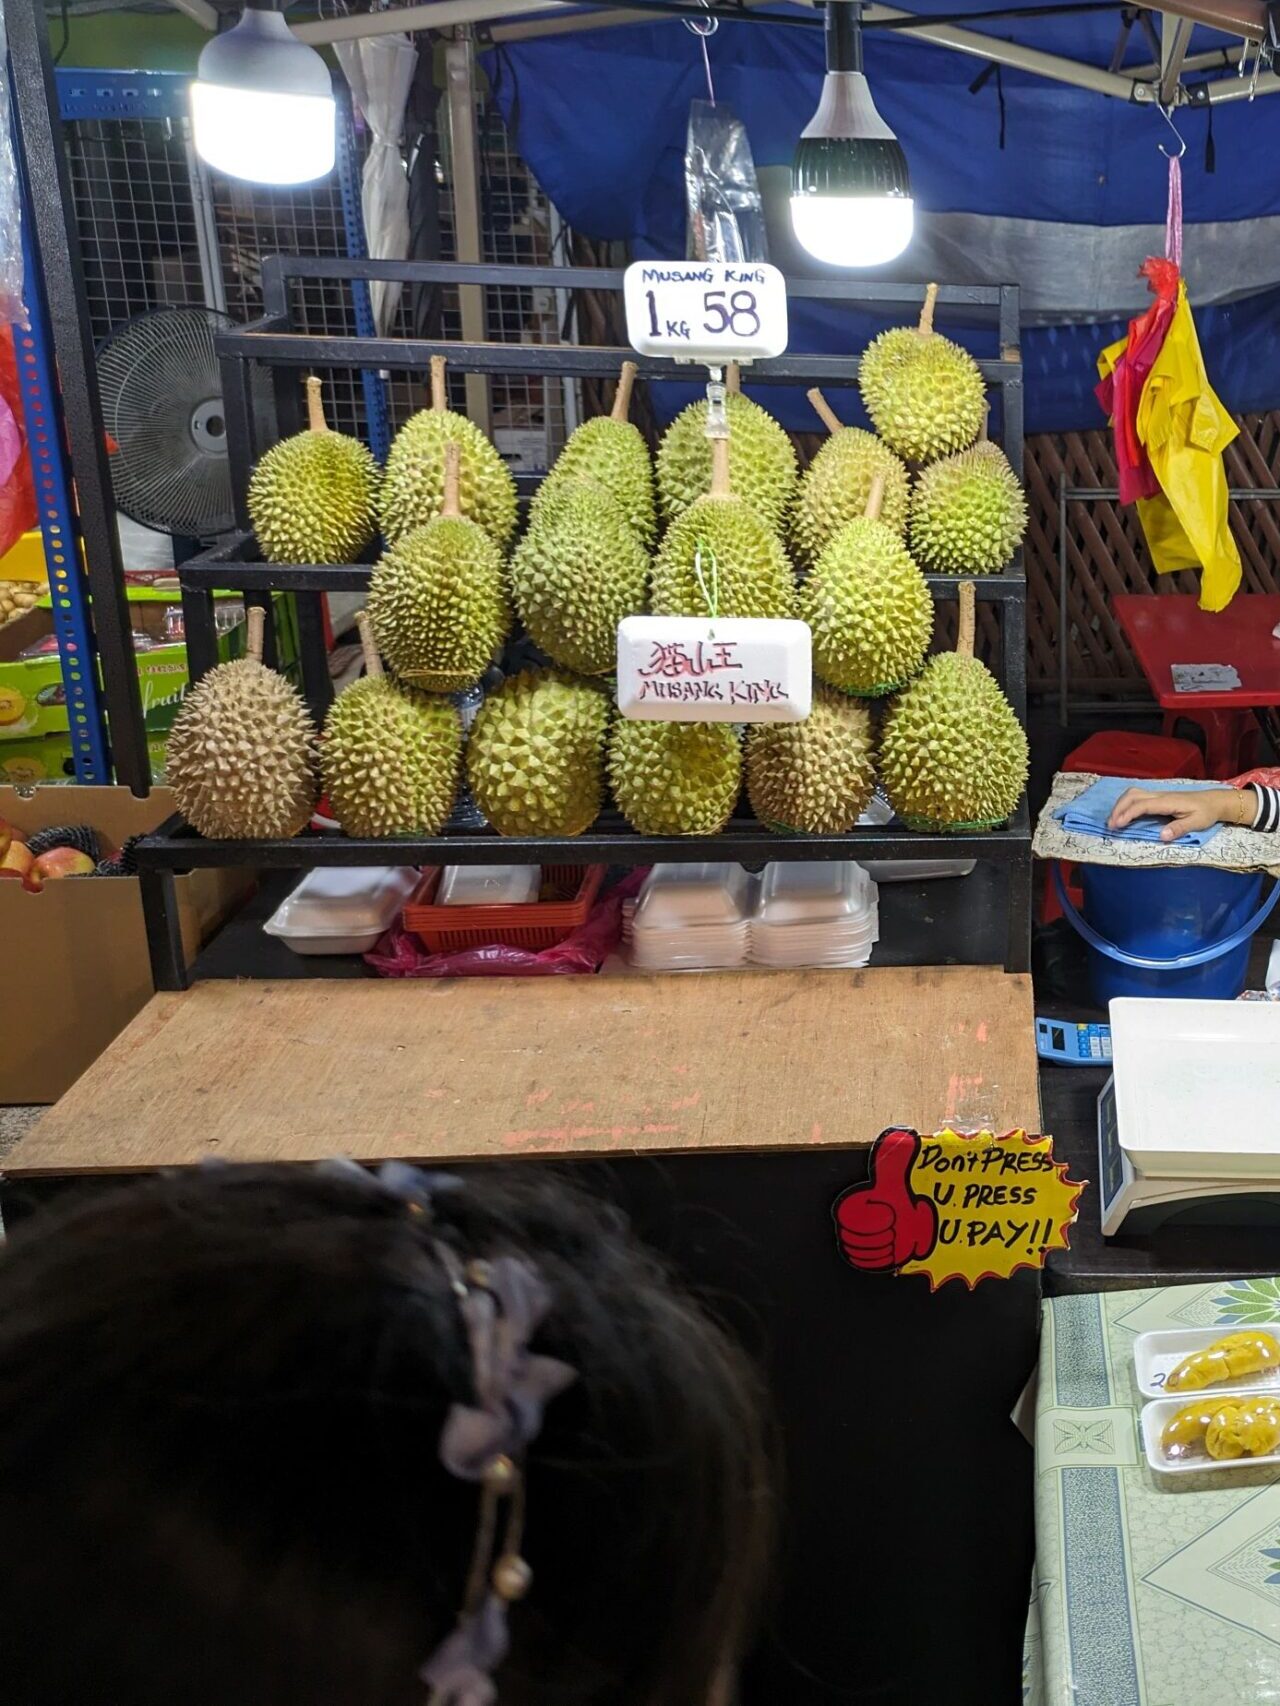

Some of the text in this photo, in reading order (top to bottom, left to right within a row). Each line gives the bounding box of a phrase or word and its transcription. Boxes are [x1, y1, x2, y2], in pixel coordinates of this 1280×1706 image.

[642, 268, 766, 284] MUSANG KING
[703, 290, 761, 337] 58
[639, 679, 789, 704] MUSANG KING
[980, 1146, 1053, 1175] PRESS
[962, 1183, 1037, 1209] PRESS
[1150, 1371, 1181, 1388] 20
